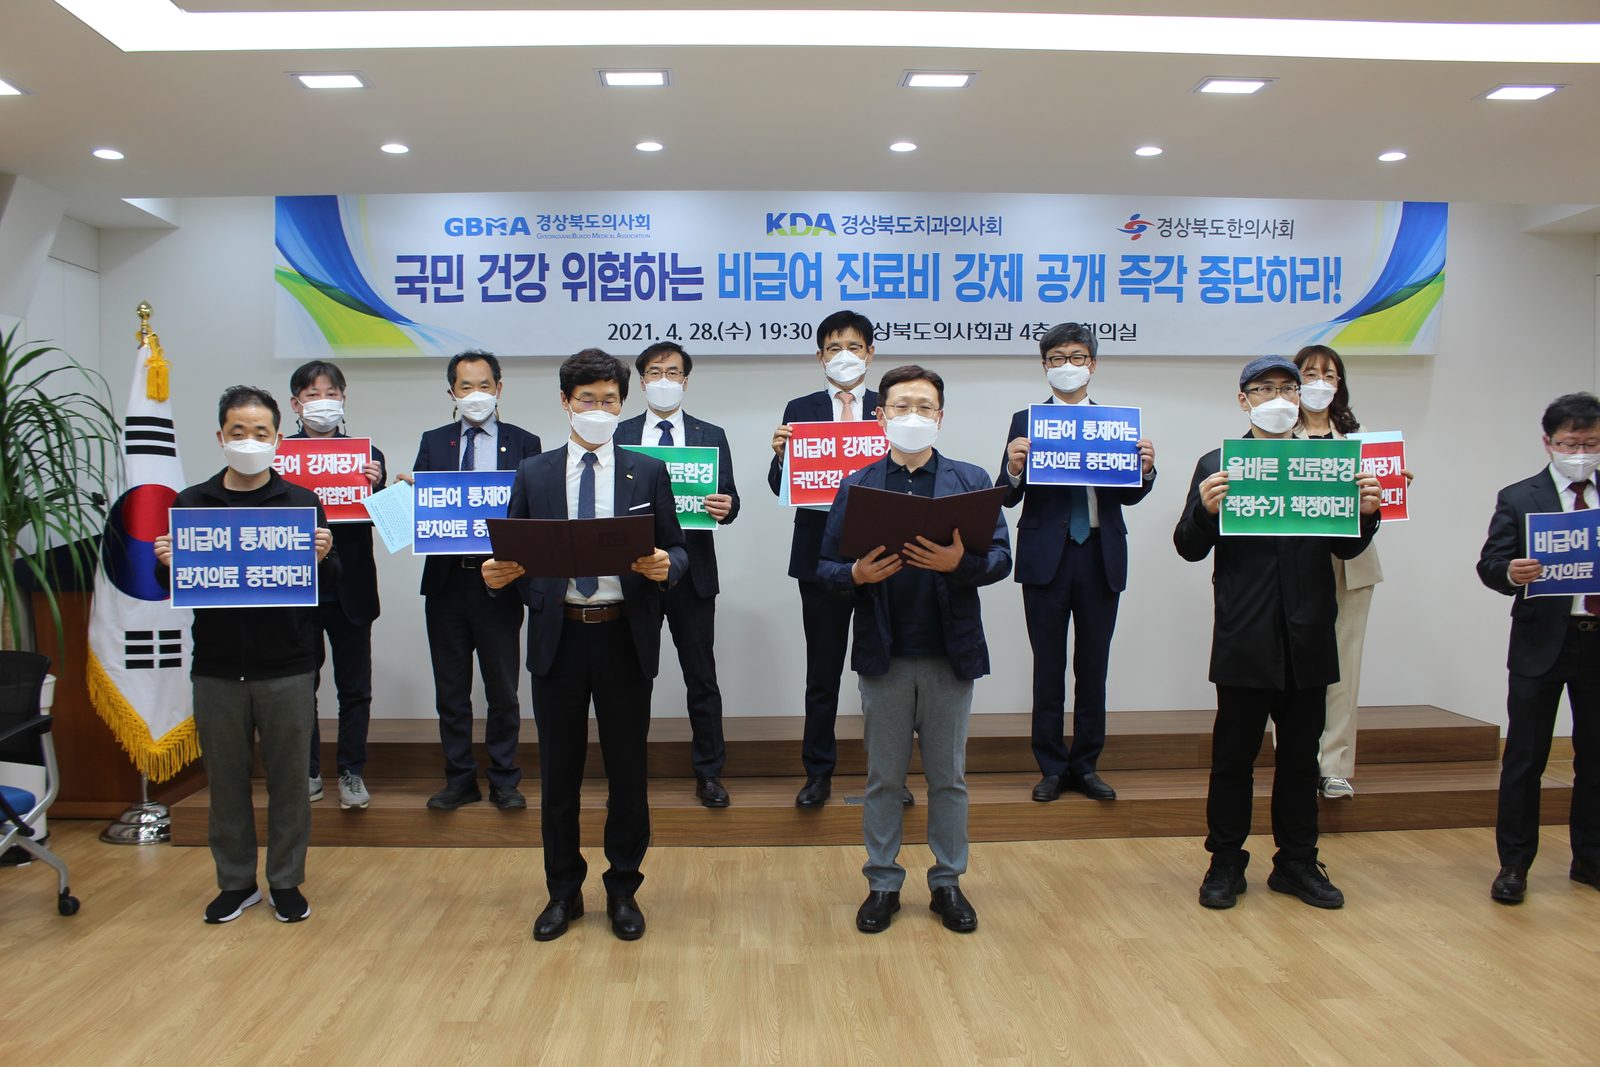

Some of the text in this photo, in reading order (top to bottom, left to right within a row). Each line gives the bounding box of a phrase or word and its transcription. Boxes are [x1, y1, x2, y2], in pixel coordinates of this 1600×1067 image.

[444, 216, 531, 237] GBMA
[536, 213, 651, 232] 경상북도의사회
[766, 212, 837, 237] KDA
[841, 214, 1002, 236] 경상북도치과의사회
[1156, 217, 1295, 240] 경상북도한의사회
[395, 250, 1342, 305] 국민 건강 위협하는 비급여 진료비 강제 공개 즉각 중단하라!
[608, 322, 660, 341] 2021.
[666, 322, 683, 341] 4.
[689, 321, 752, 341] 28.(수)
[759, 322, 813, 340] 19:30
[873, 322, 1013, 341] 상북도의사회관
[1033, 419, 1138, 441] 비급여 통제하는
[793, 435, 891, 459] 비급여 강제공
[272, 453, 367, 475] 급여 강제공개
[1031, 451, 1138, 471] 관치의료 중단하라!
[1226, 456, 1356, 482] 올바른 진료환경
[1360, 456, 1402, 477] 제공개
[666, 462, 714, 484] 료환경
[792, 469, 844, 489] 국민건강
[417, 486, 511, 508] 비급여 통제하
[1225, 495, 1355, 518] 적정수가 책정하라!
[177, 526, 312, 552] 비급여 통제하는
[416, 519, 469, 539] 관치의료
[1534, 527, 1589, 554] 비급여
[176, 565, 312, 589] 관치의료 중단하라!
